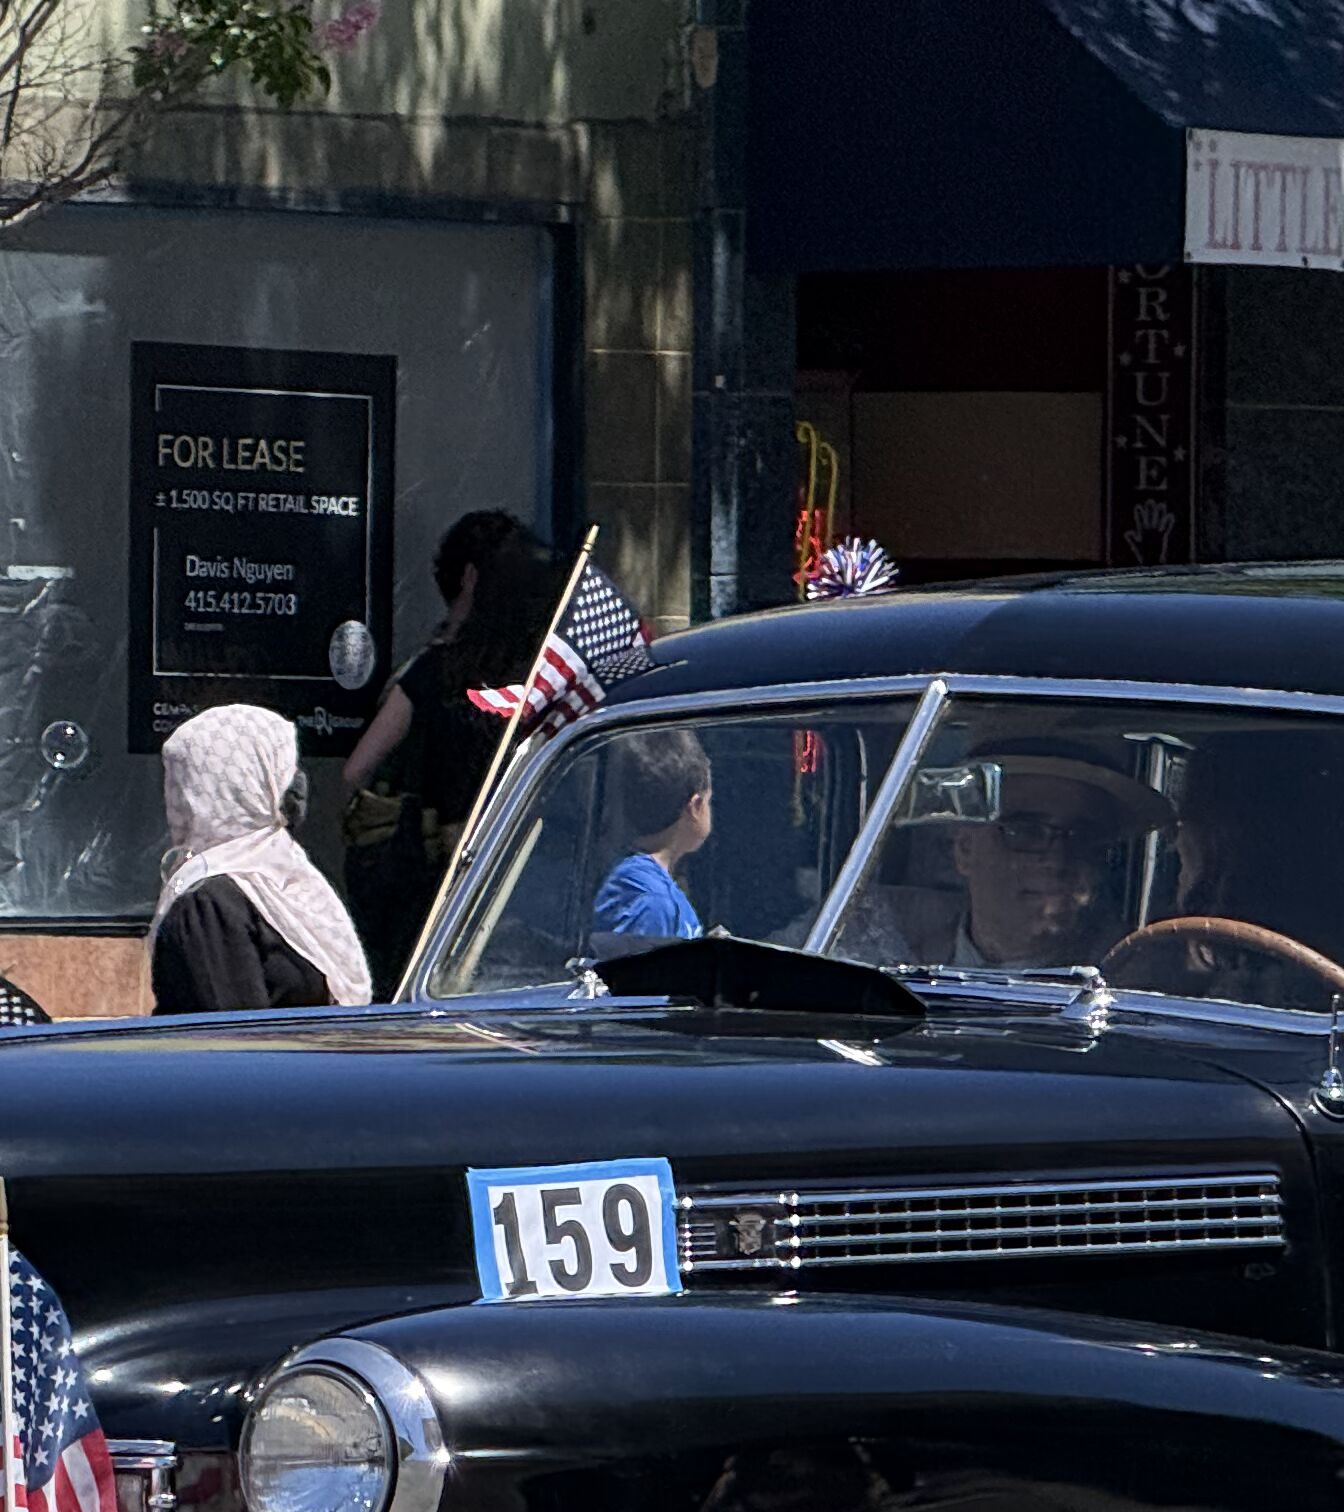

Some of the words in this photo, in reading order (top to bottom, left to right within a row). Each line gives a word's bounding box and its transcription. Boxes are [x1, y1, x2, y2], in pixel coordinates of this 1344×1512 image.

[158, 434, 216, 468] FOR
[222, 437, 305, 473] LEASE
[212, 491, 233, 513] SQ
[237, 492, 255, 511] FT
[258, 493, 308, 513] RETAIL
[310, 495, 360, 516] SPACE
[185, 555, 230, 578] Davis
[233, 557, 294, 584] Nguyen
[184, 590, 296, 615] 415.412.5703
[493, 1184, 653, 1295] 159
